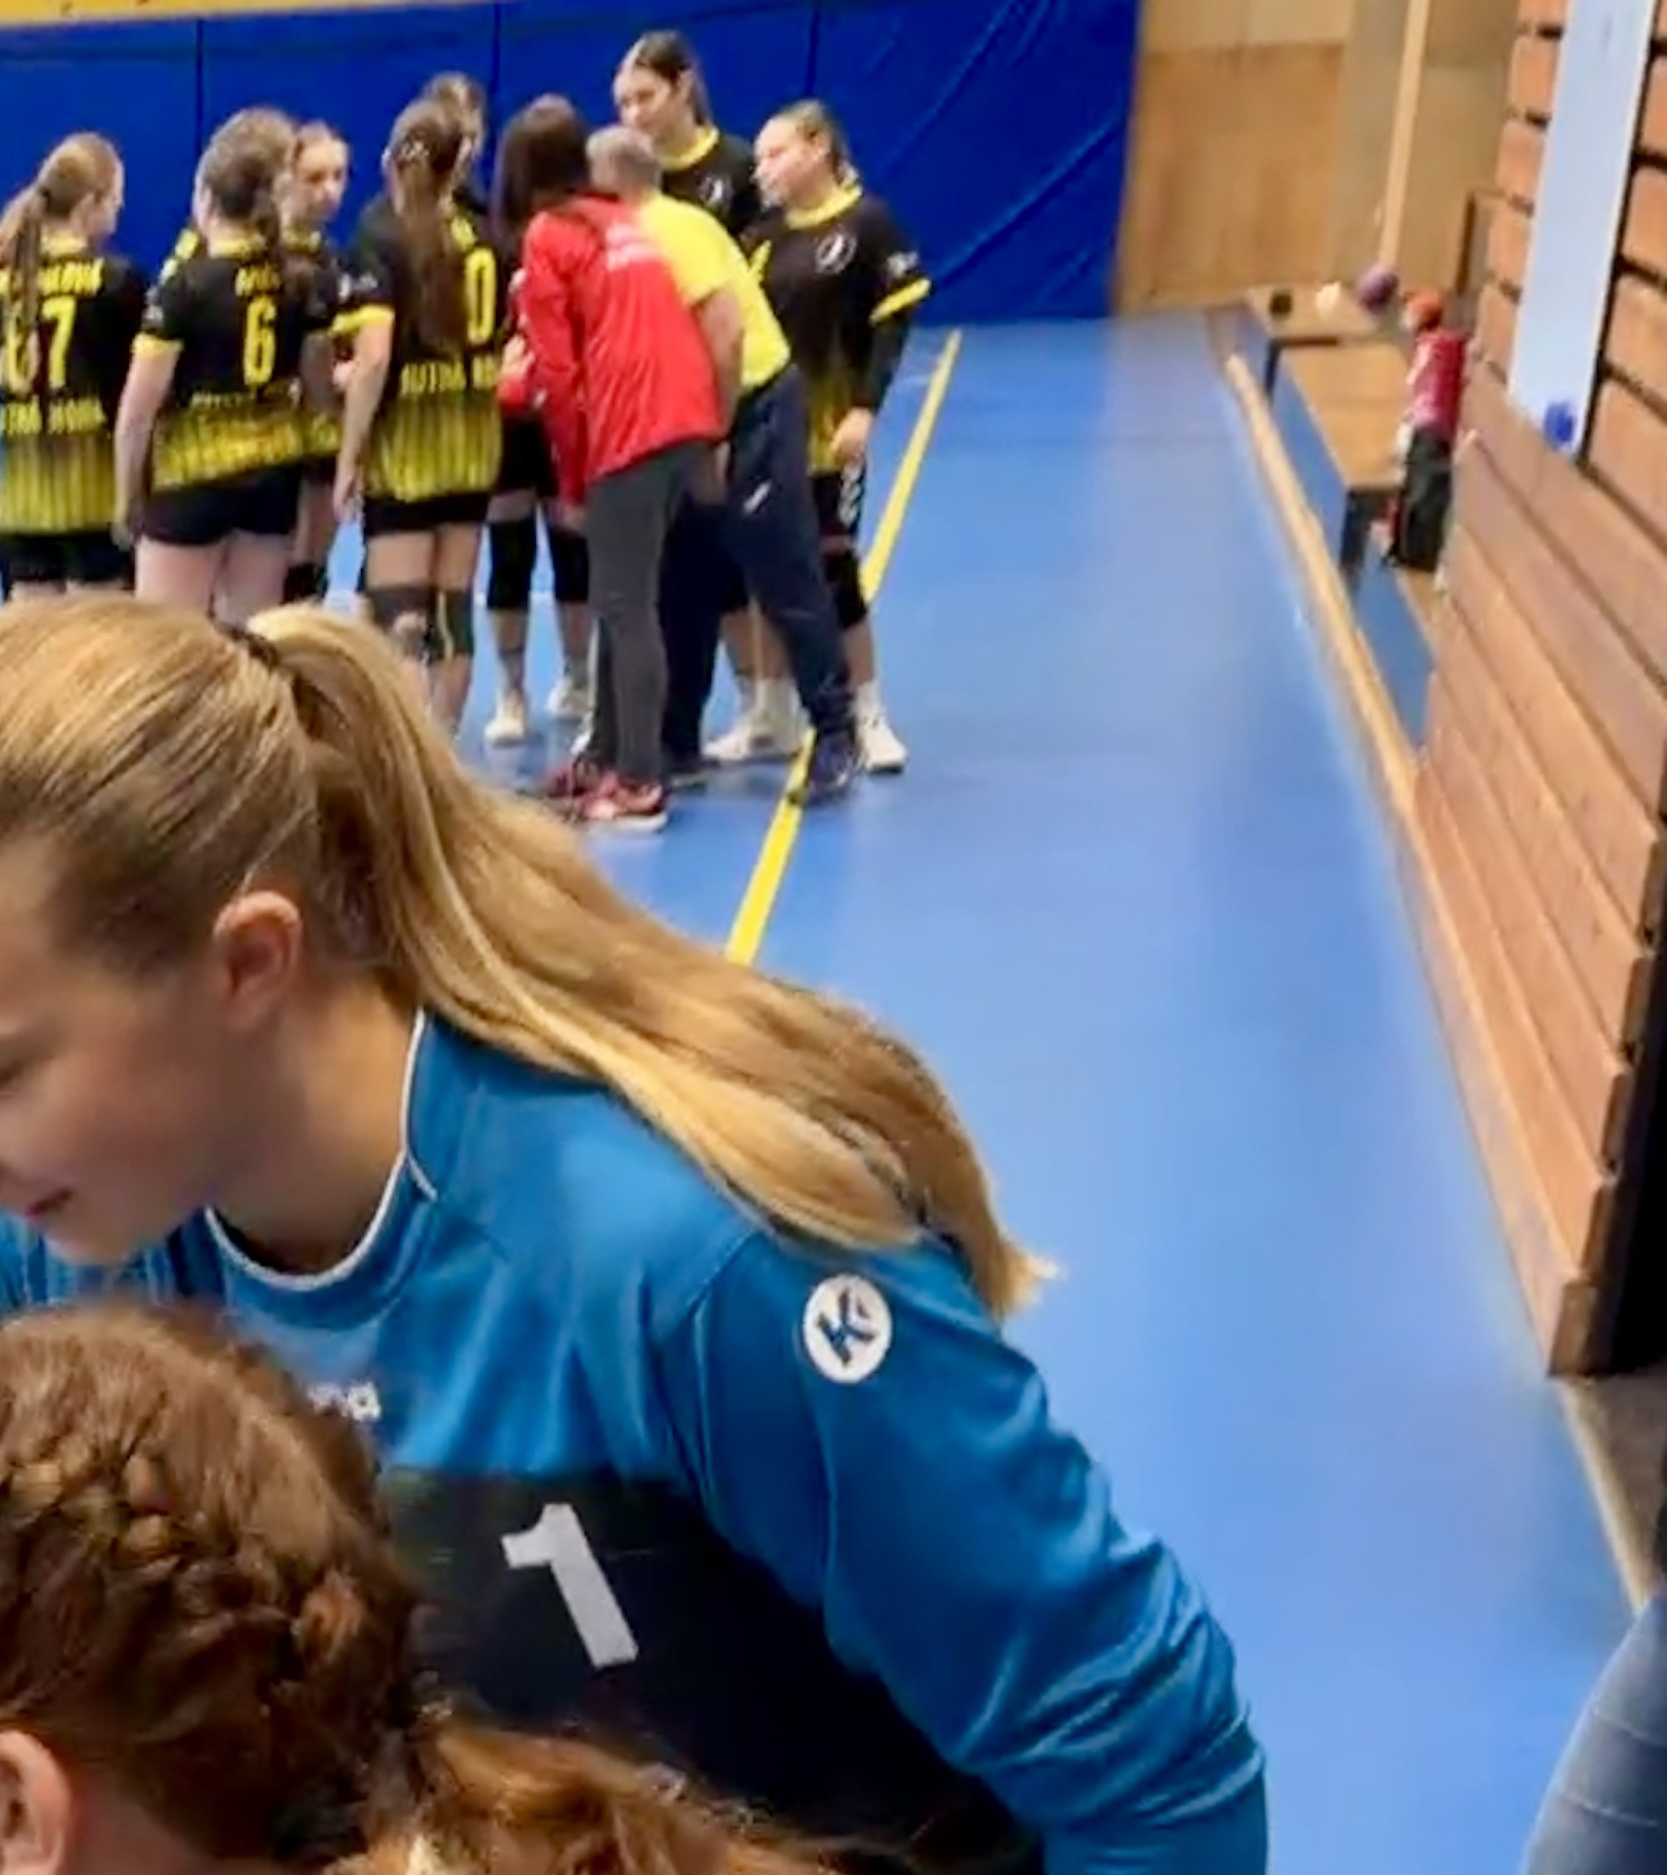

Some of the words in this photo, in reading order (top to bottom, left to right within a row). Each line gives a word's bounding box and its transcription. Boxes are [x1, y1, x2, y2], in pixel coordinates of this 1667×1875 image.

[243, 298, 277, 386] 6
[464, 248, 496, 343] 0
[500, 1502, 640, 1669] 1
